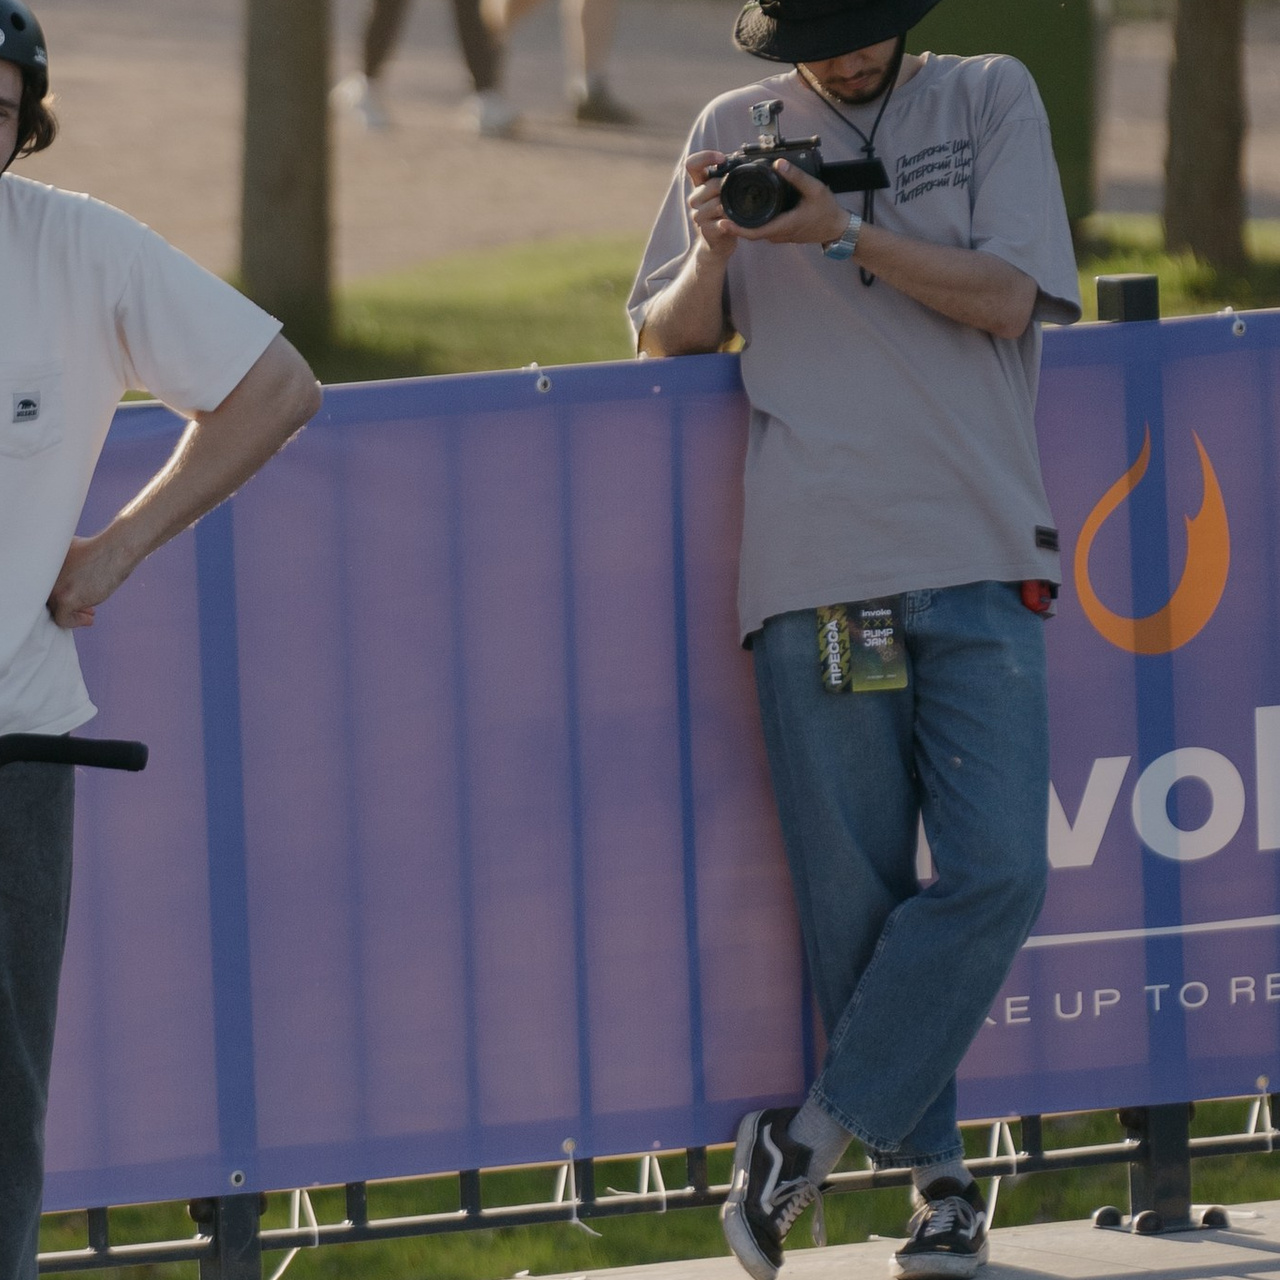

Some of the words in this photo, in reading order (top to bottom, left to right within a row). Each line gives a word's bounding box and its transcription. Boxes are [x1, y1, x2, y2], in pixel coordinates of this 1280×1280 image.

[861, 609, 892, 617] invoke
[827, 619, 842, 685] ПРЕССА
[863, 628, 894, 638] PUMP
[1047, 705, 1280, 869] vo
[1055, 988, 1121, 1019] UP
[1144, 981, 1210, 1011] TO
